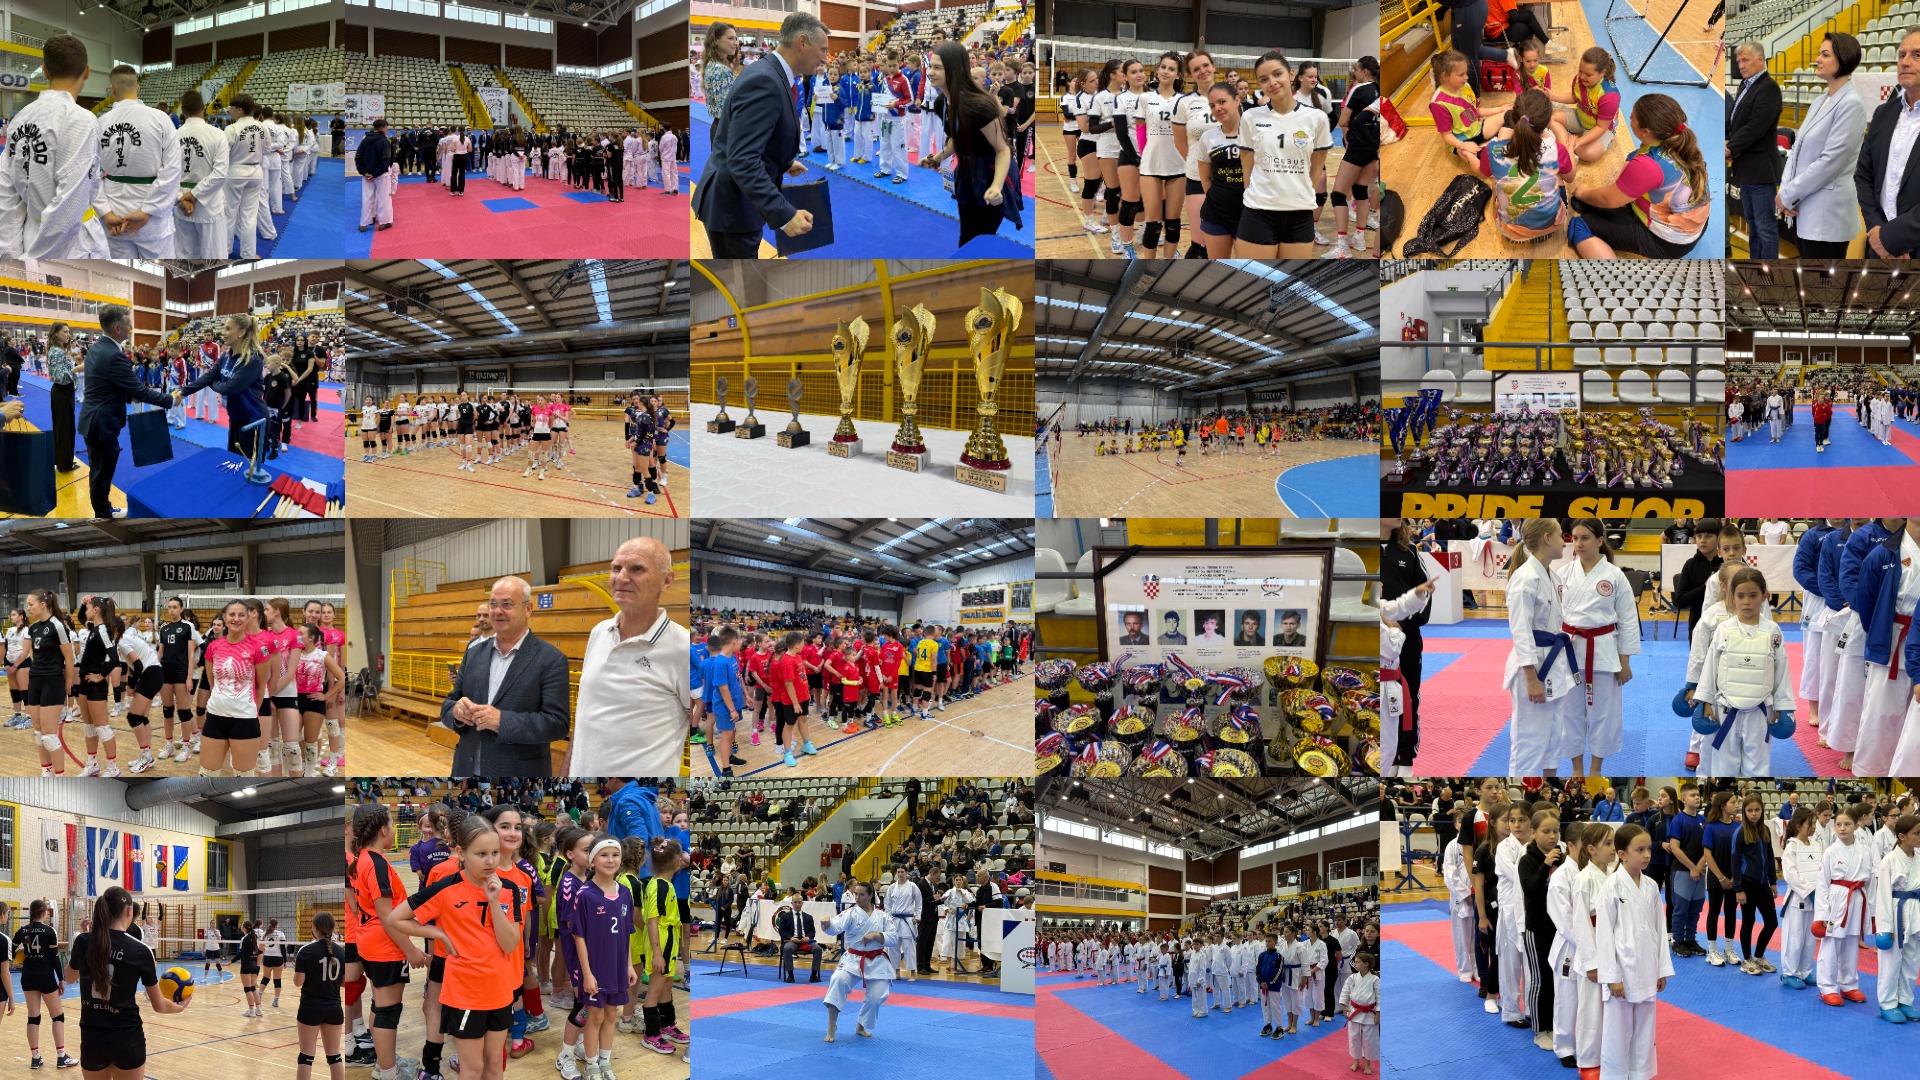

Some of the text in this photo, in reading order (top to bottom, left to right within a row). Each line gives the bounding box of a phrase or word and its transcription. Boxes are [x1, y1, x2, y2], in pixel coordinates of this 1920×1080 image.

[1158, 110, 1171, 121] 12
[101, 122, 142, 149] TAEKWON-DO
[1276, 133, 1285, 149] 1
[1225, 146, 1240, 160] 19
[1508, 161, 1542, 206] 2
[967, 474, 1000, 486] MJESTO
[1401, 492, 1706, 518] PRIDE SHOP
[162, 564, 176, 580] 19
[167, 634, 176, 644] 18
[917, 648, 928, 661] 14
[476, 901, 489, 928] 7
[610, 916, 619, 934] 2
[24, 934, 42, 954] 14
[318, 956, 341, 982] 10
[400, 960, 410, 977] 2
